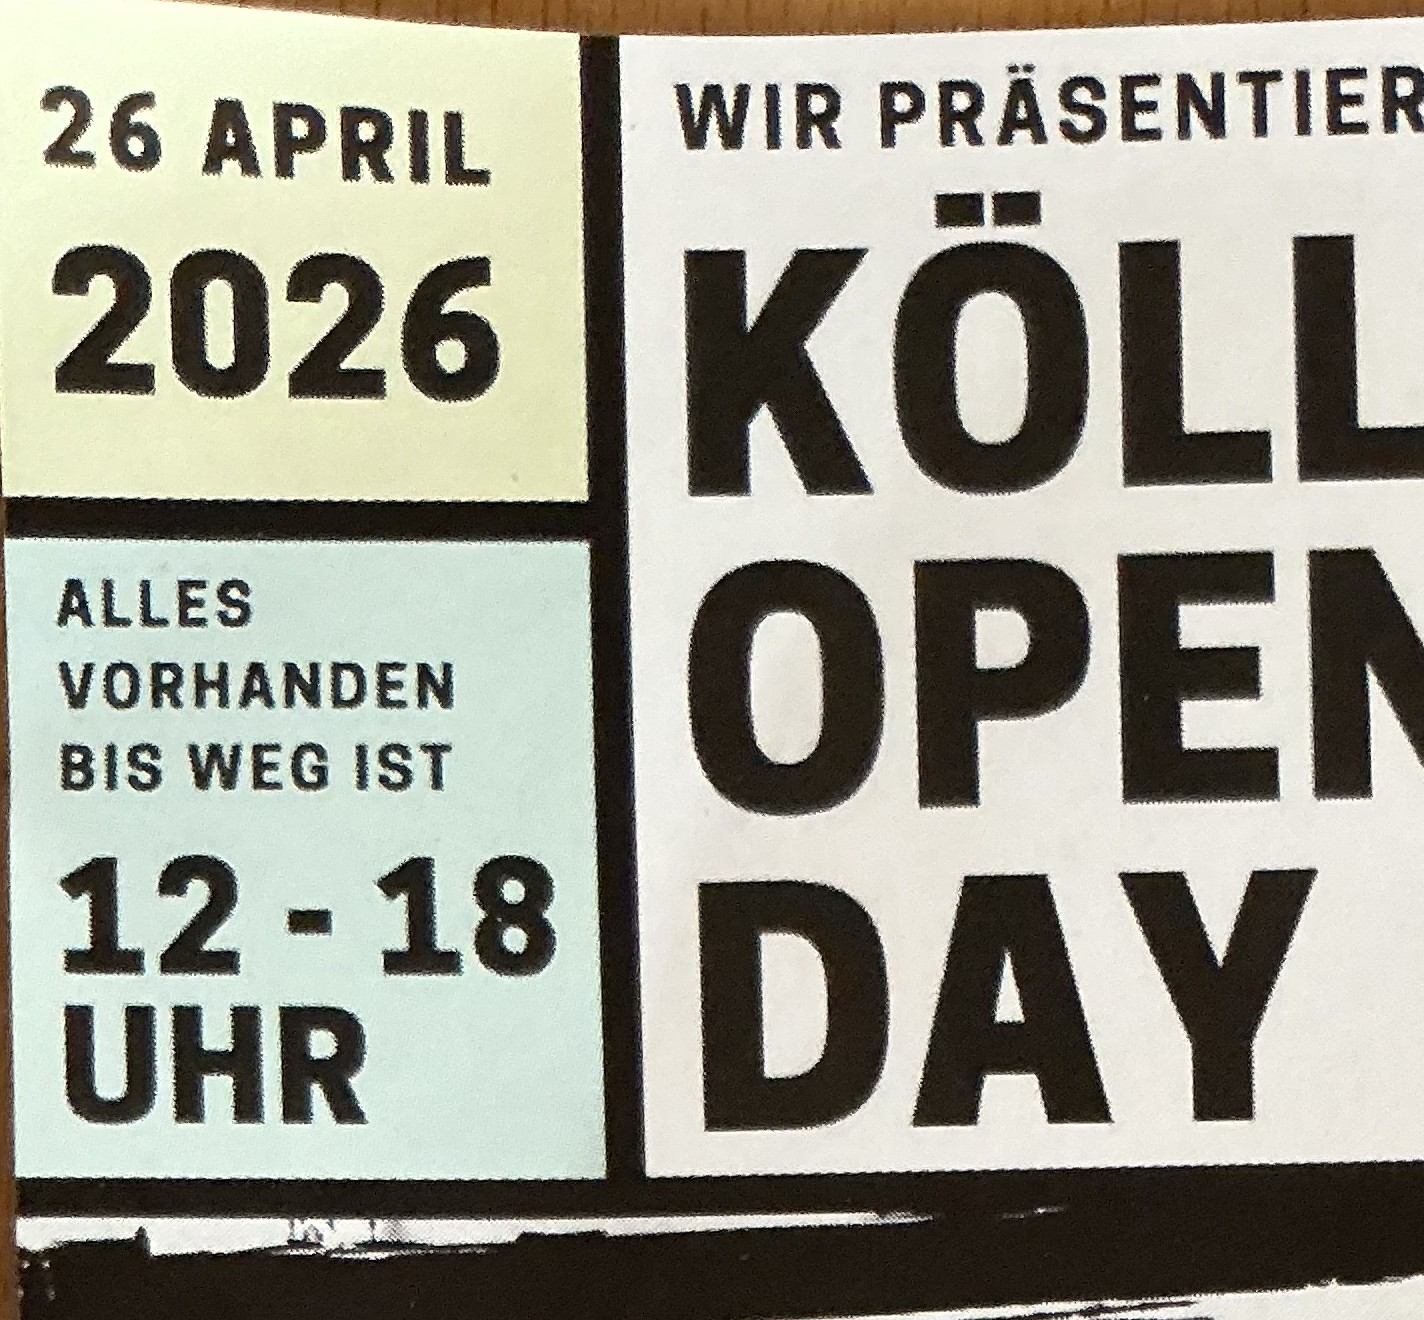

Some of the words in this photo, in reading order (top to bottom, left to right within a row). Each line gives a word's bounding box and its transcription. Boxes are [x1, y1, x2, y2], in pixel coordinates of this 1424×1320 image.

[42, 85, 162, 171] 26
[202, 99, 491, 186] APRIL
[674, 83, 841, 150] WIR
[52, 244, 500, 402] 2026
[57, 578, 252, 628] ALLES
[59, 661, 454, 710] VORHANDEN
[61, 743, 162, 792] BIS
[188, 742, 328, 791] WEG
[355, 743, 452, 792] IST
[60, 854, 240, 975] 12
[287, 909, 332, 934] -
[376, 855, 556, 976] 18
[698, 868, 1318, 1132] DAY
[64, 1004, 366, 1124] UHR
